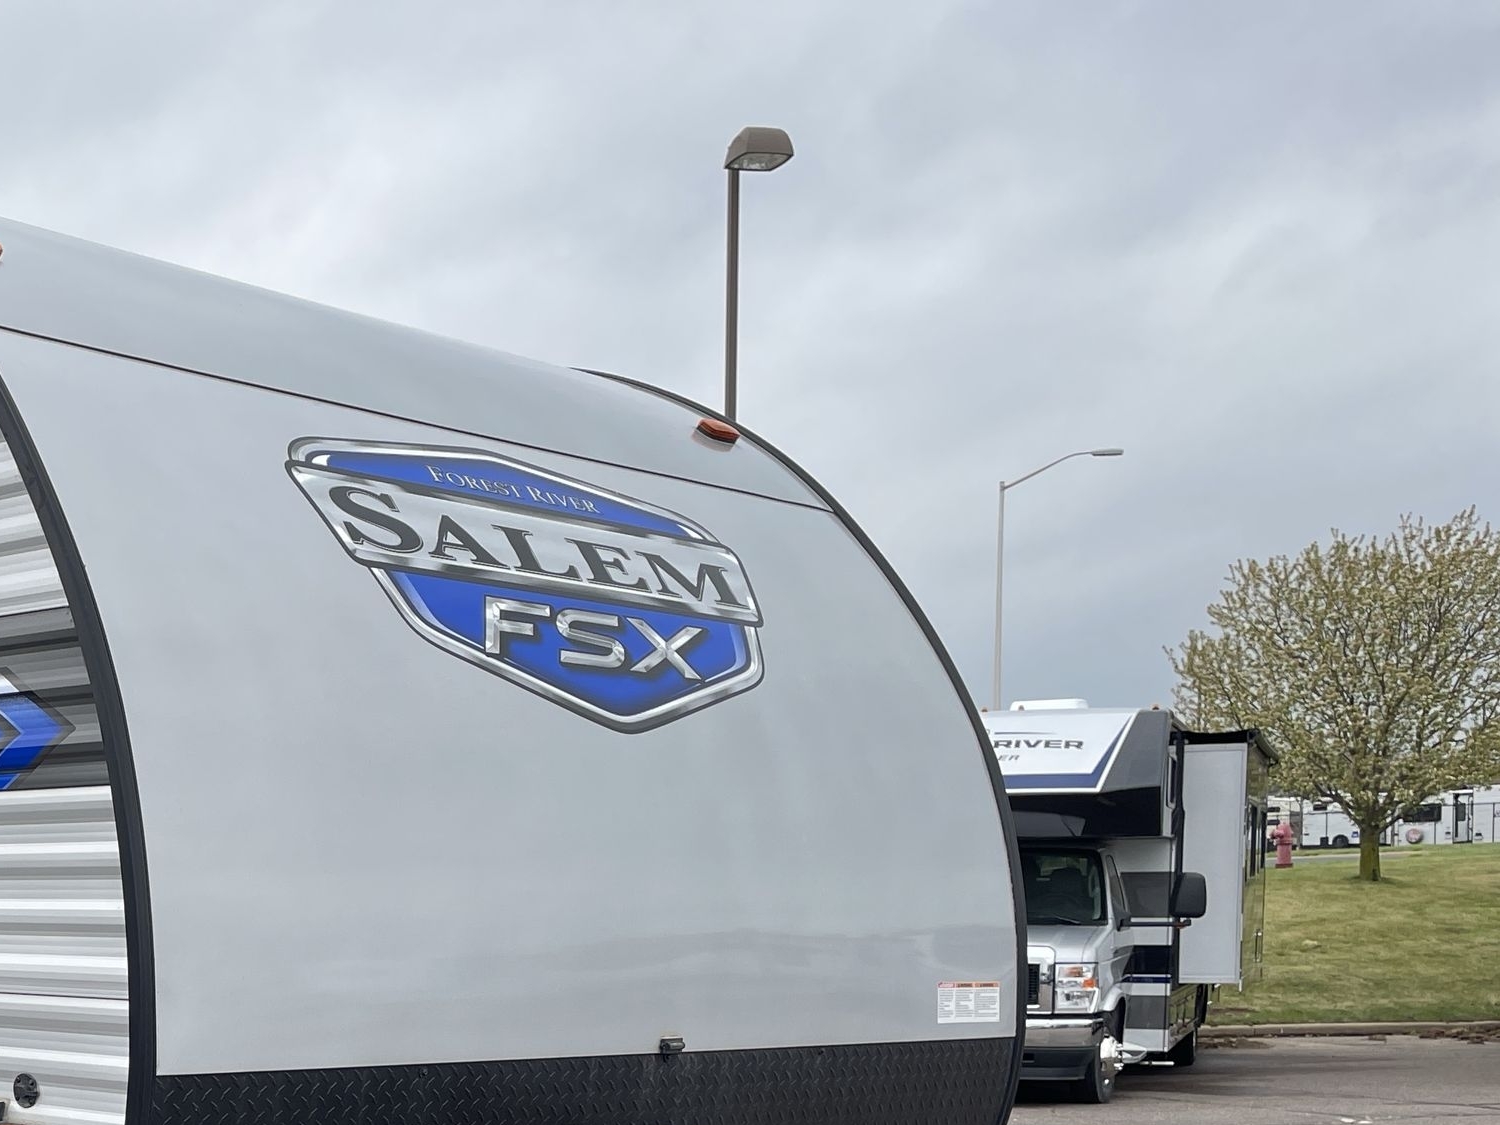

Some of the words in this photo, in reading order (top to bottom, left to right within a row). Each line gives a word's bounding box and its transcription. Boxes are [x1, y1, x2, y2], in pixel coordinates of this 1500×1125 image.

[426, 464, 524, 499] FOREST
[525, 485, 602, 515] RIVER
[328, 484, 749, 609] SALEM
[483, 595, 707, 682] FSX
[993, 739, 1084, 750] RIVER
